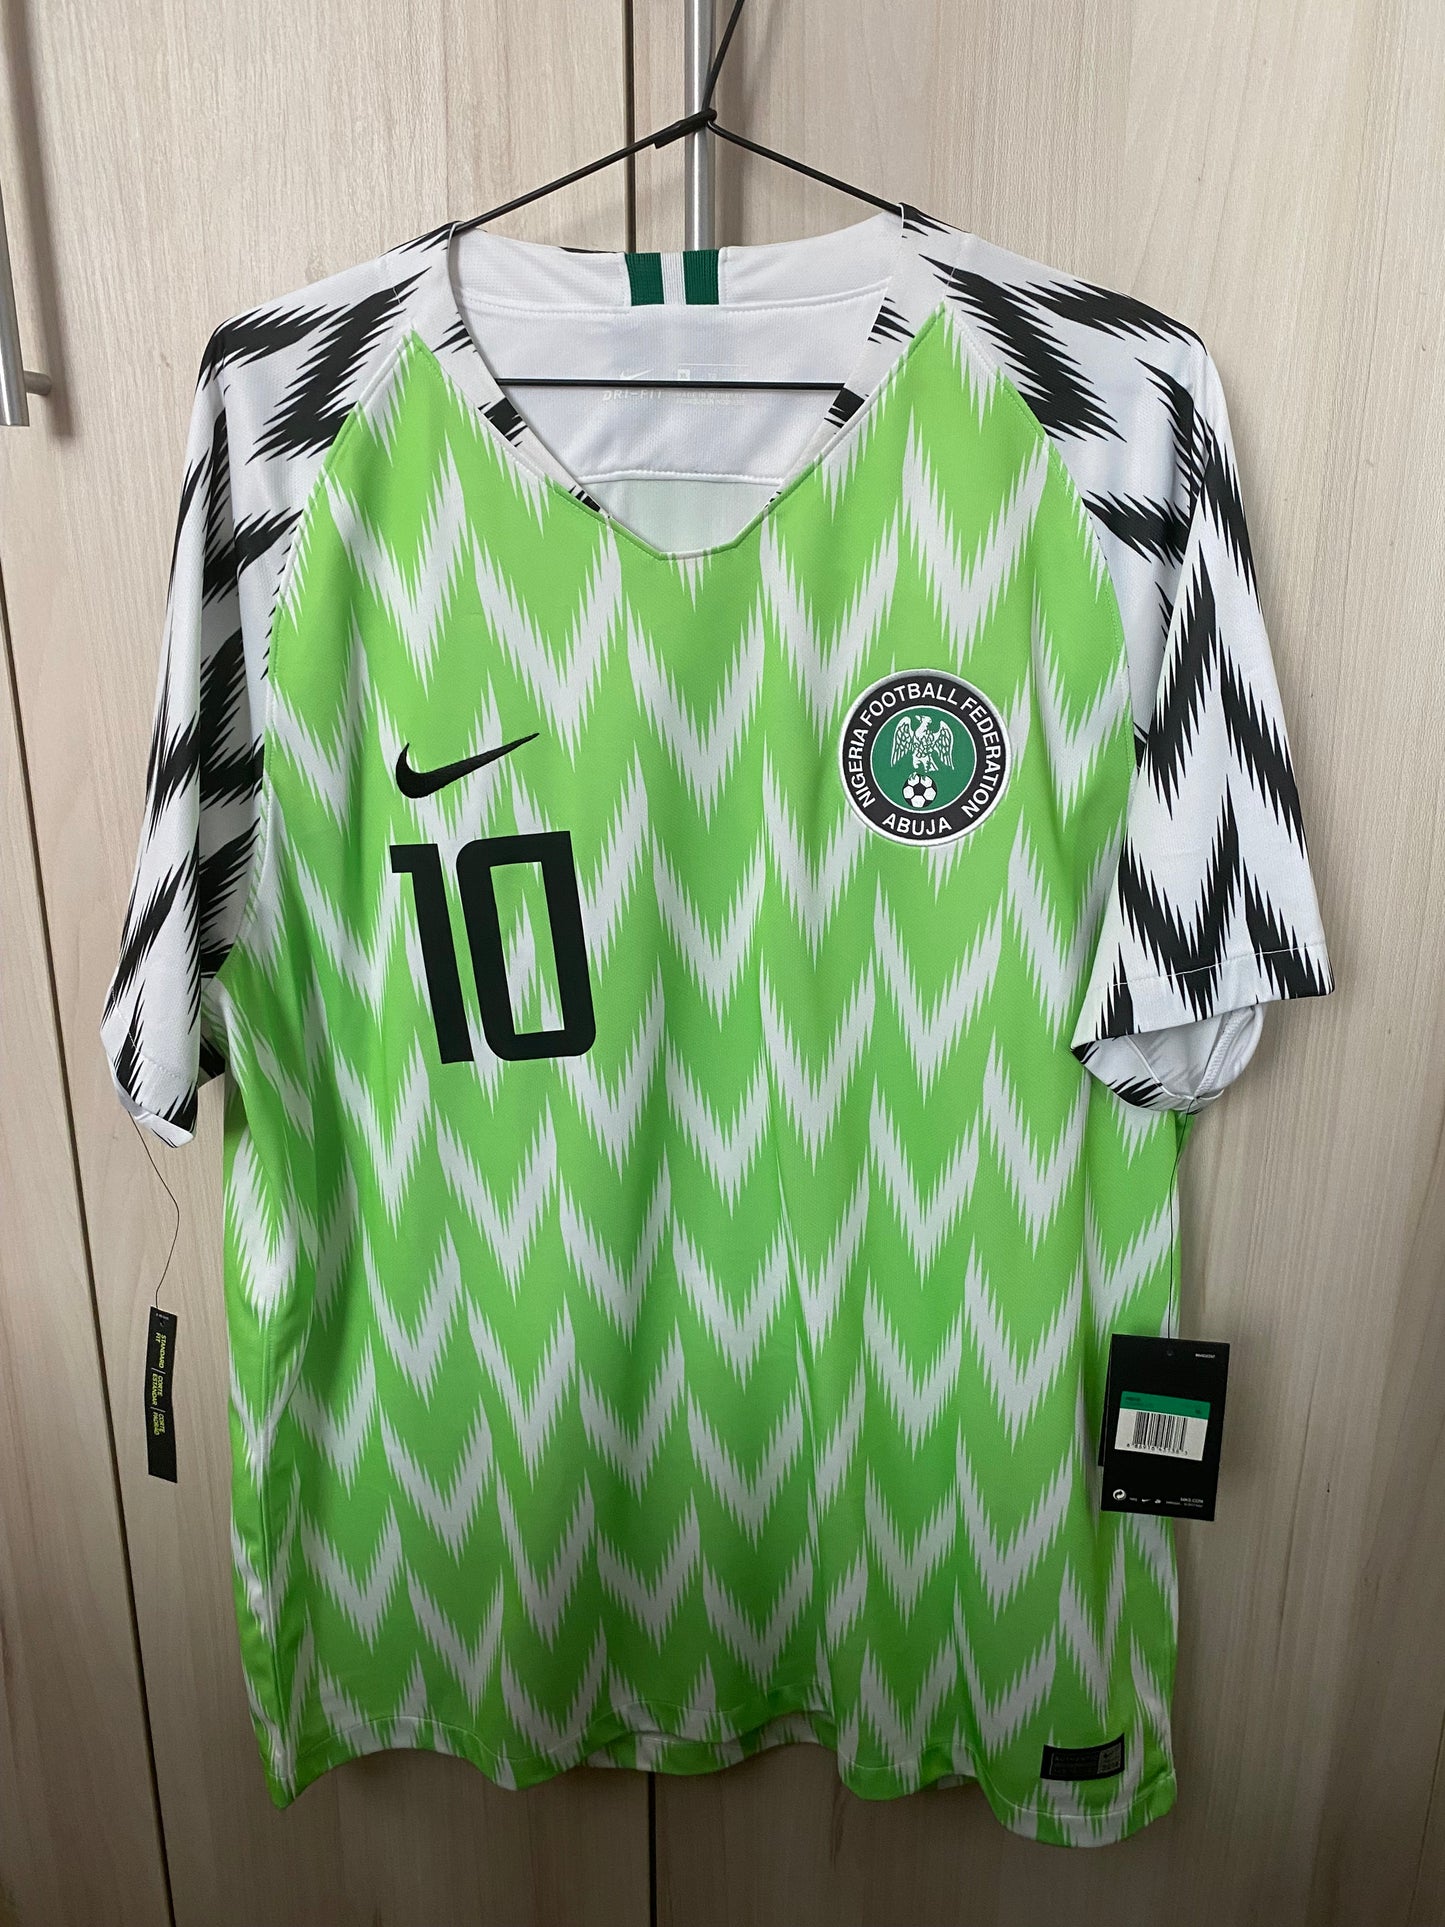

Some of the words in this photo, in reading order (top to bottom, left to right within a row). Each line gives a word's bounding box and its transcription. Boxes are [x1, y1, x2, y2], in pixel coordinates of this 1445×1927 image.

[860, 682, 958, 727] FOOTBALL
[848, 727, 876, 808] NIGERIA
[960, 696, 1001, 818] FEDERATION
[882, 813, 952, 835] ABUJA
[389, 830, 596, 1064] 10
